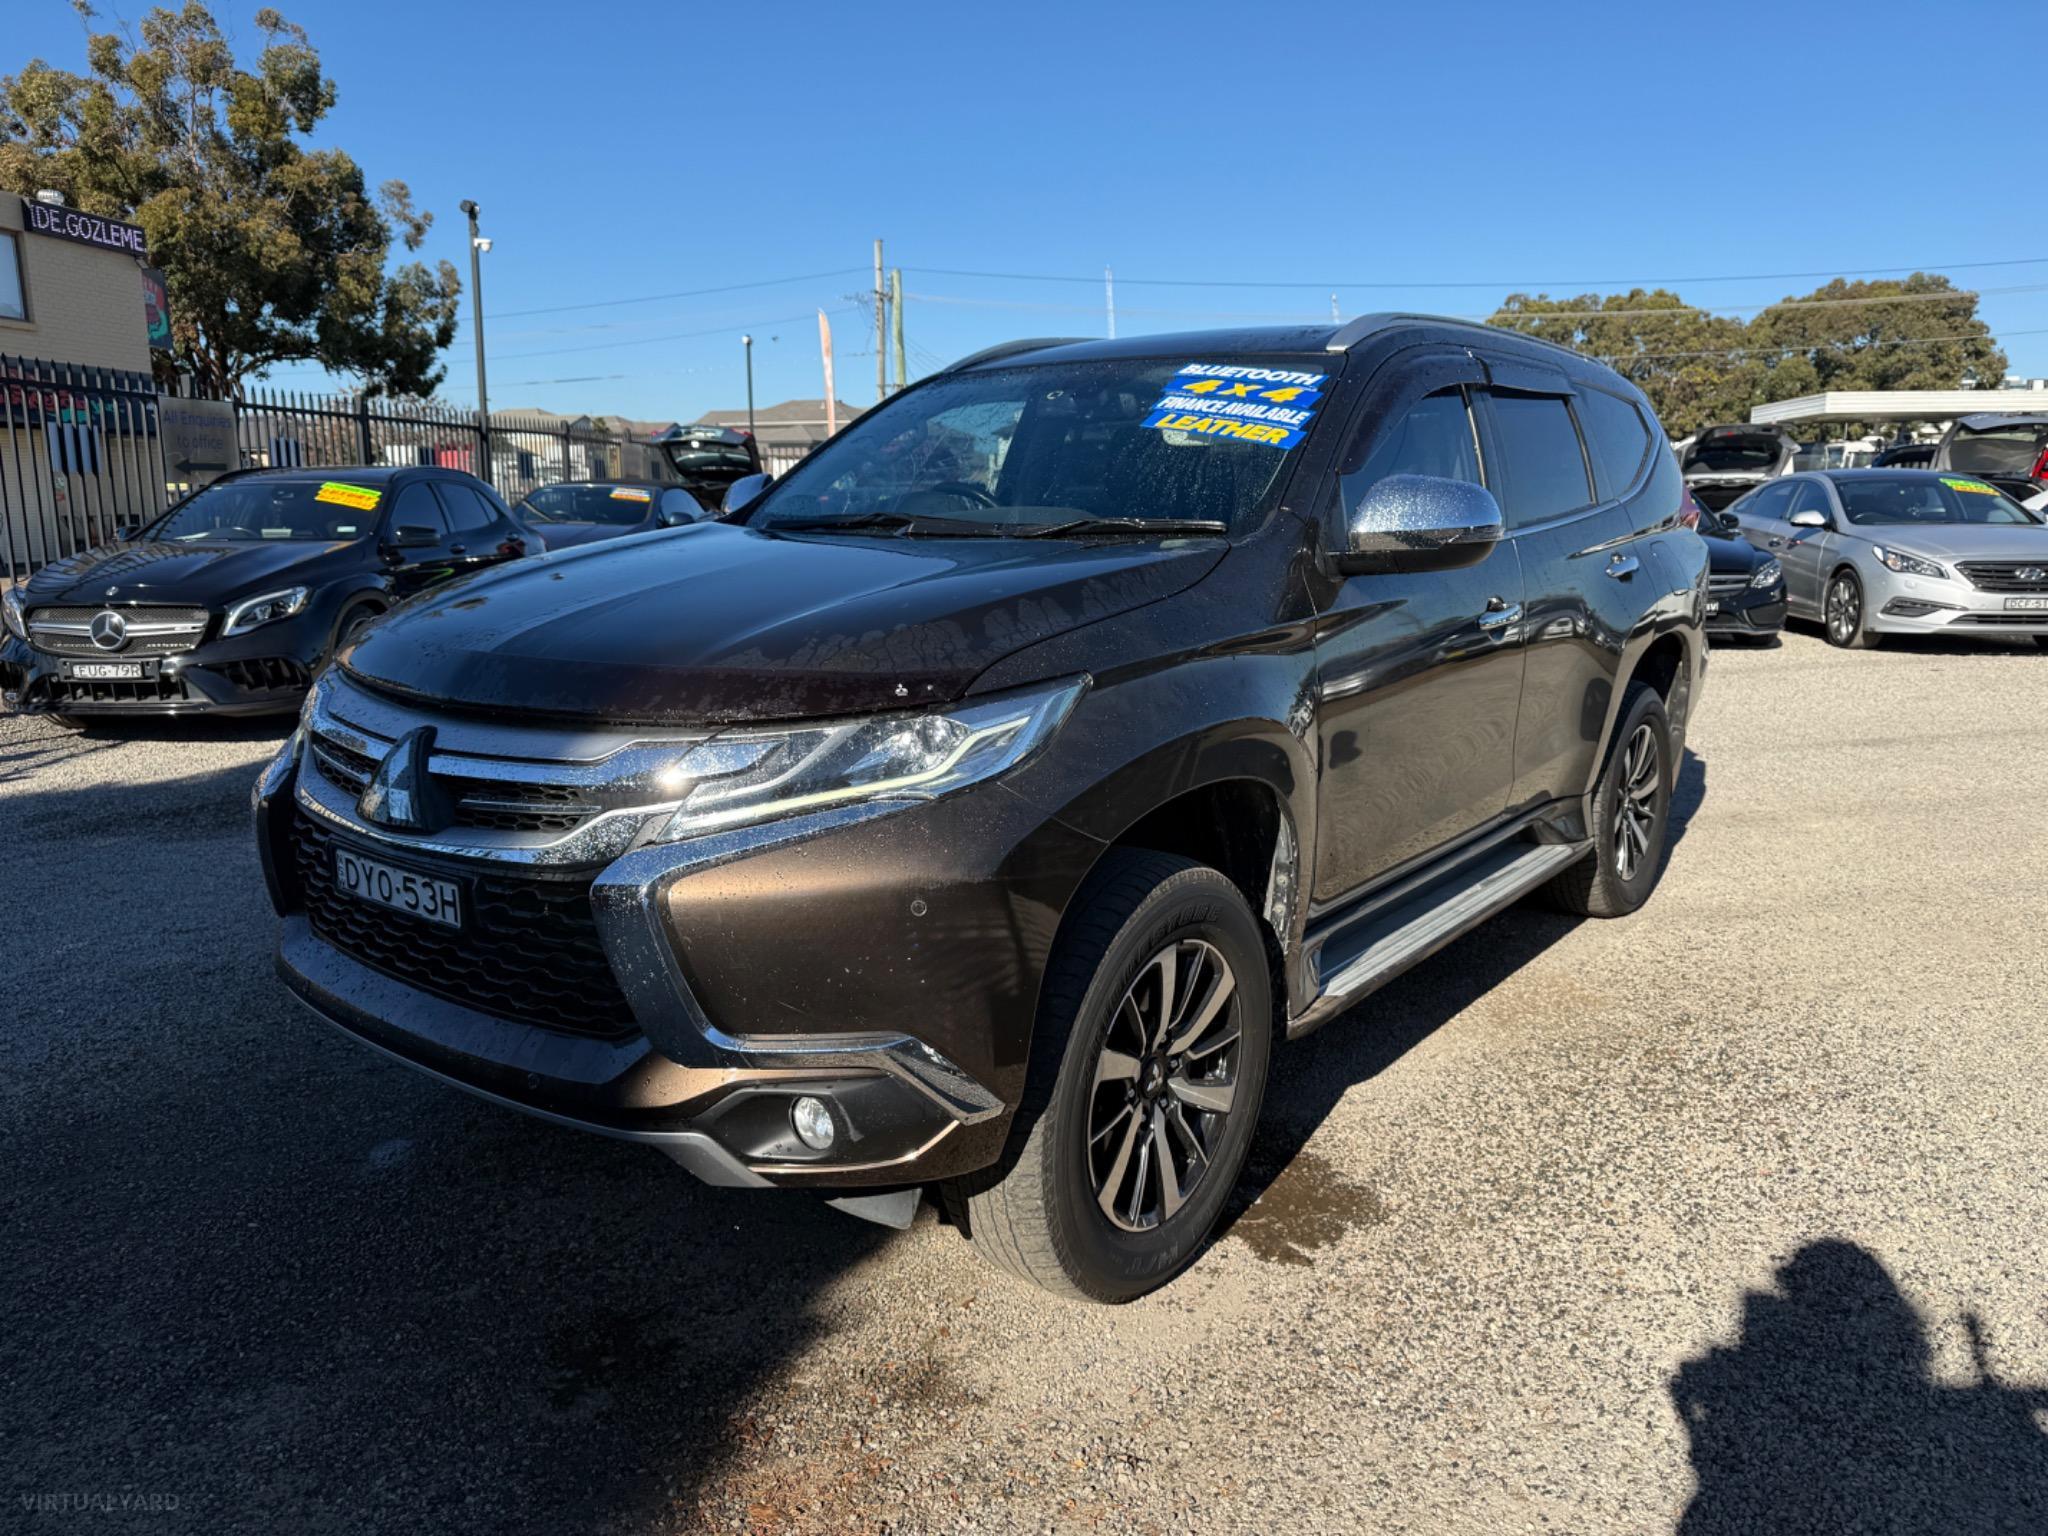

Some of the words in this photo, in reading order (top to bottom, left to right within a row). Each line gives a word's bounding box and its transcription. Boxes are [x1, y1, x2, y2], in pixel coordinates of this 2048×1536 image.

[1178, 364, 1323, 386] BLUETOOTH
[164, 409, 176, 425] All
[1156, 396, 1235, 414] FINANCE
[1224, 401, 1311, 425] AVAILABLE
[1154, 414, 1290, 444] LEATHER
[176, 434, 190, 449] to
